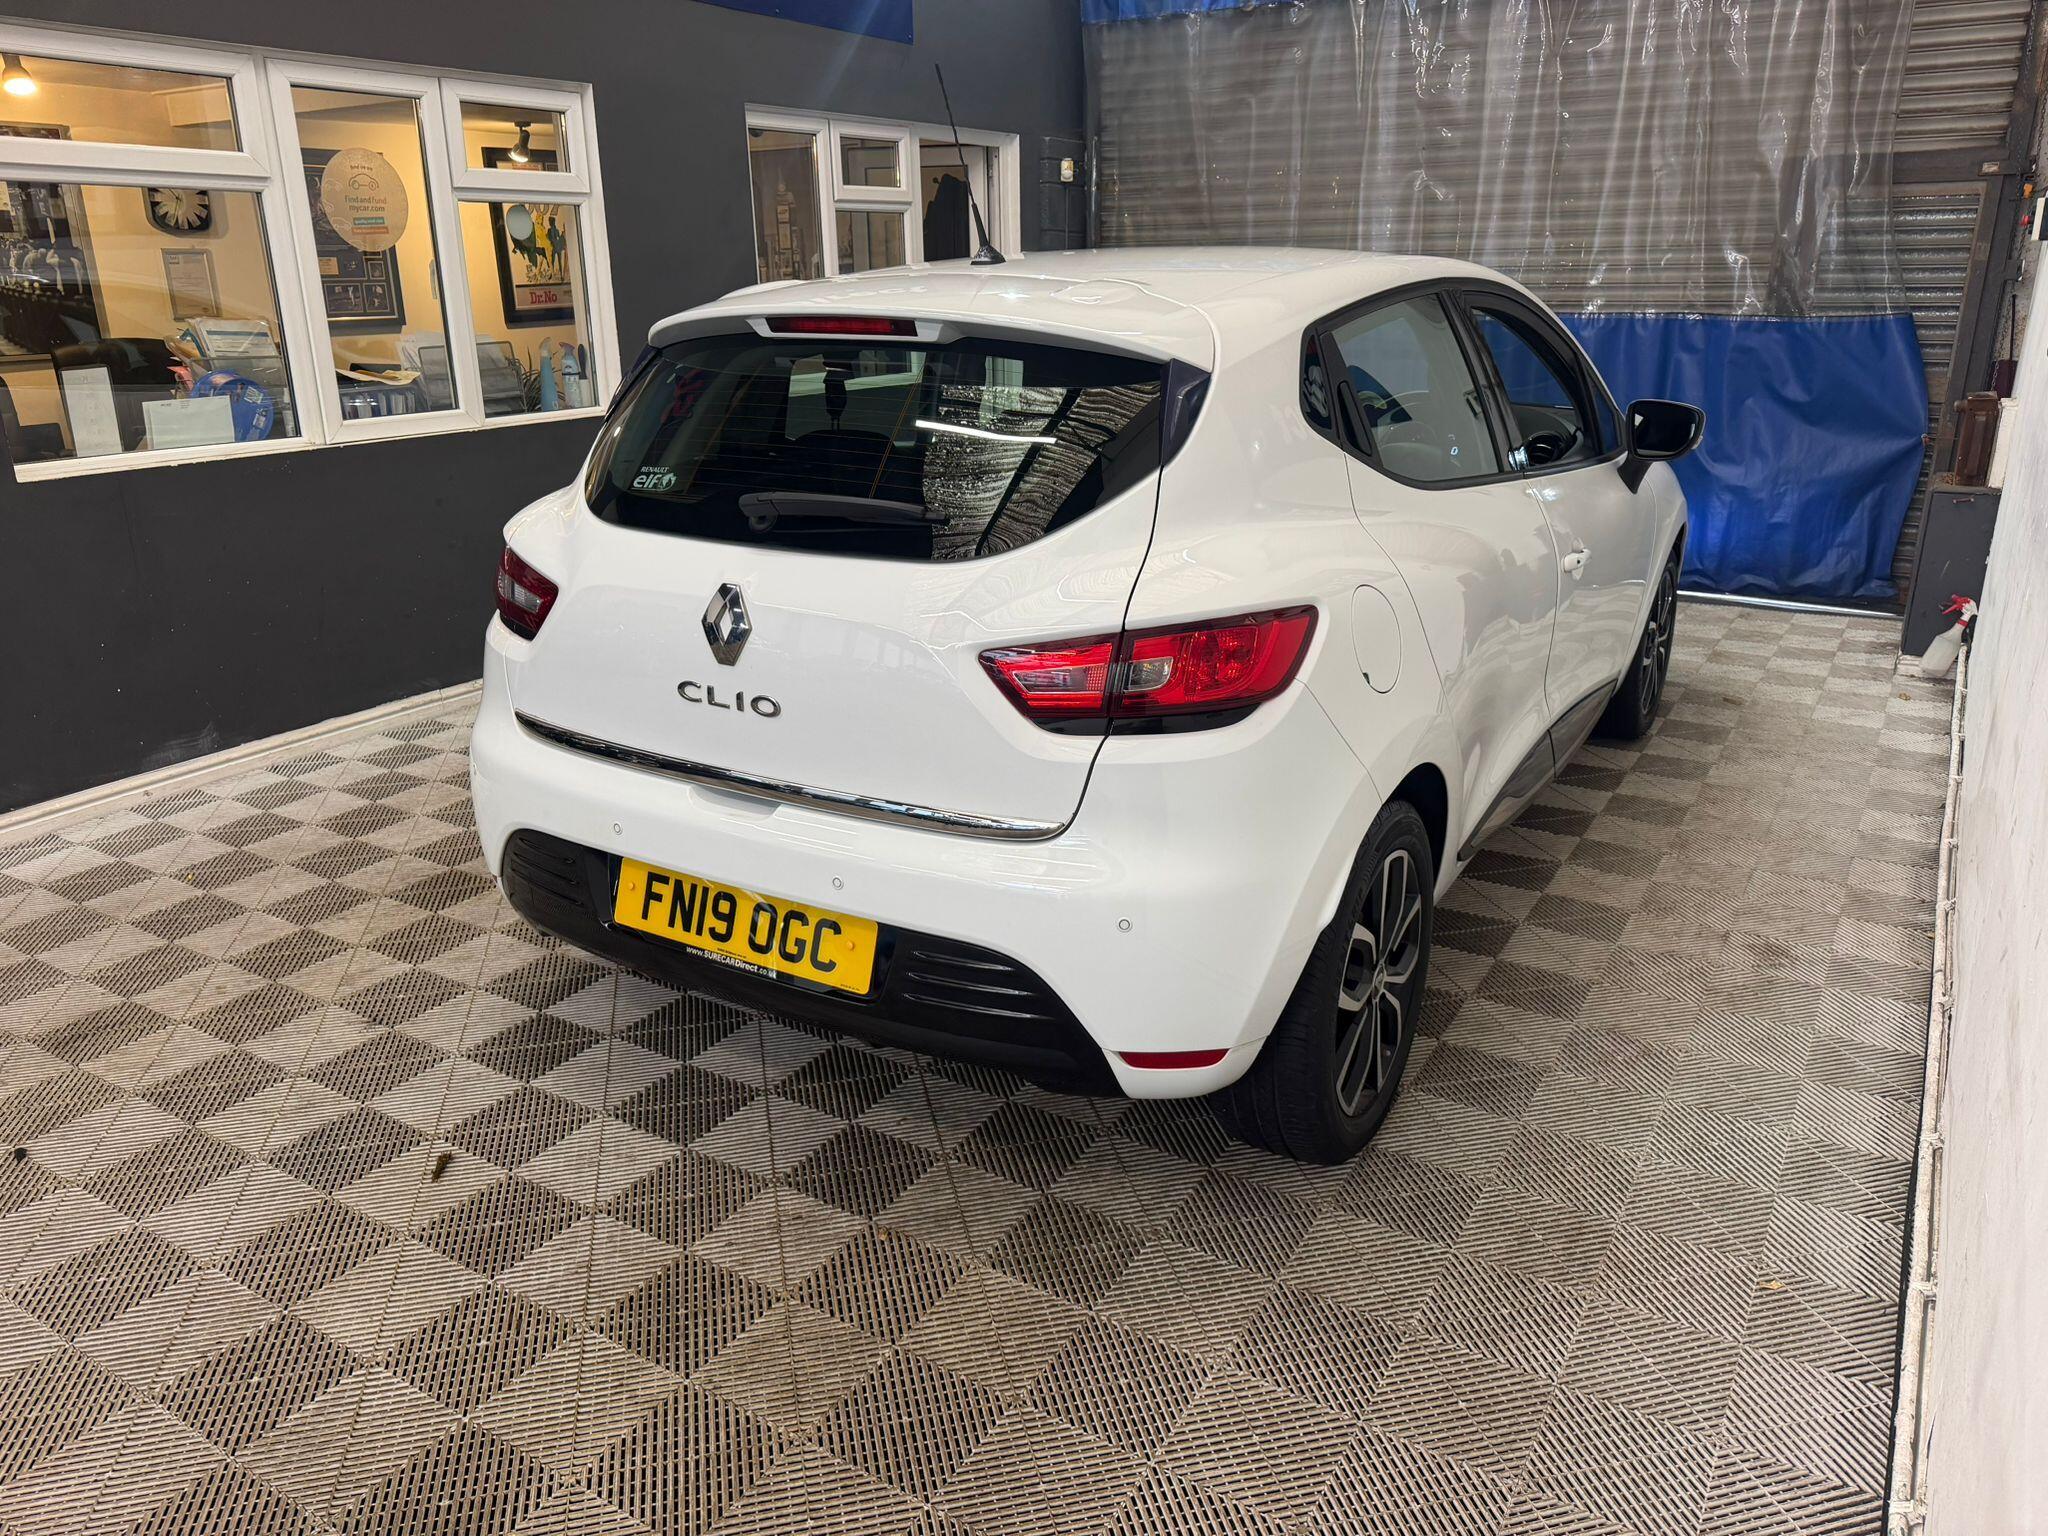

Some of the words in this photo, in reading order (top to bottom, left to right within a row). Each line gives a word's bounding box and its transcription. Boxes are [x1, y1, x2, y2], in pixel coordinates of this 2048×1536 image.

[633, 474, 662, 488] elf
[677, 680, 782, 718] CLIO
[641, 871, 738, 943] FN19
[748, 901, 842, 973] OGC
